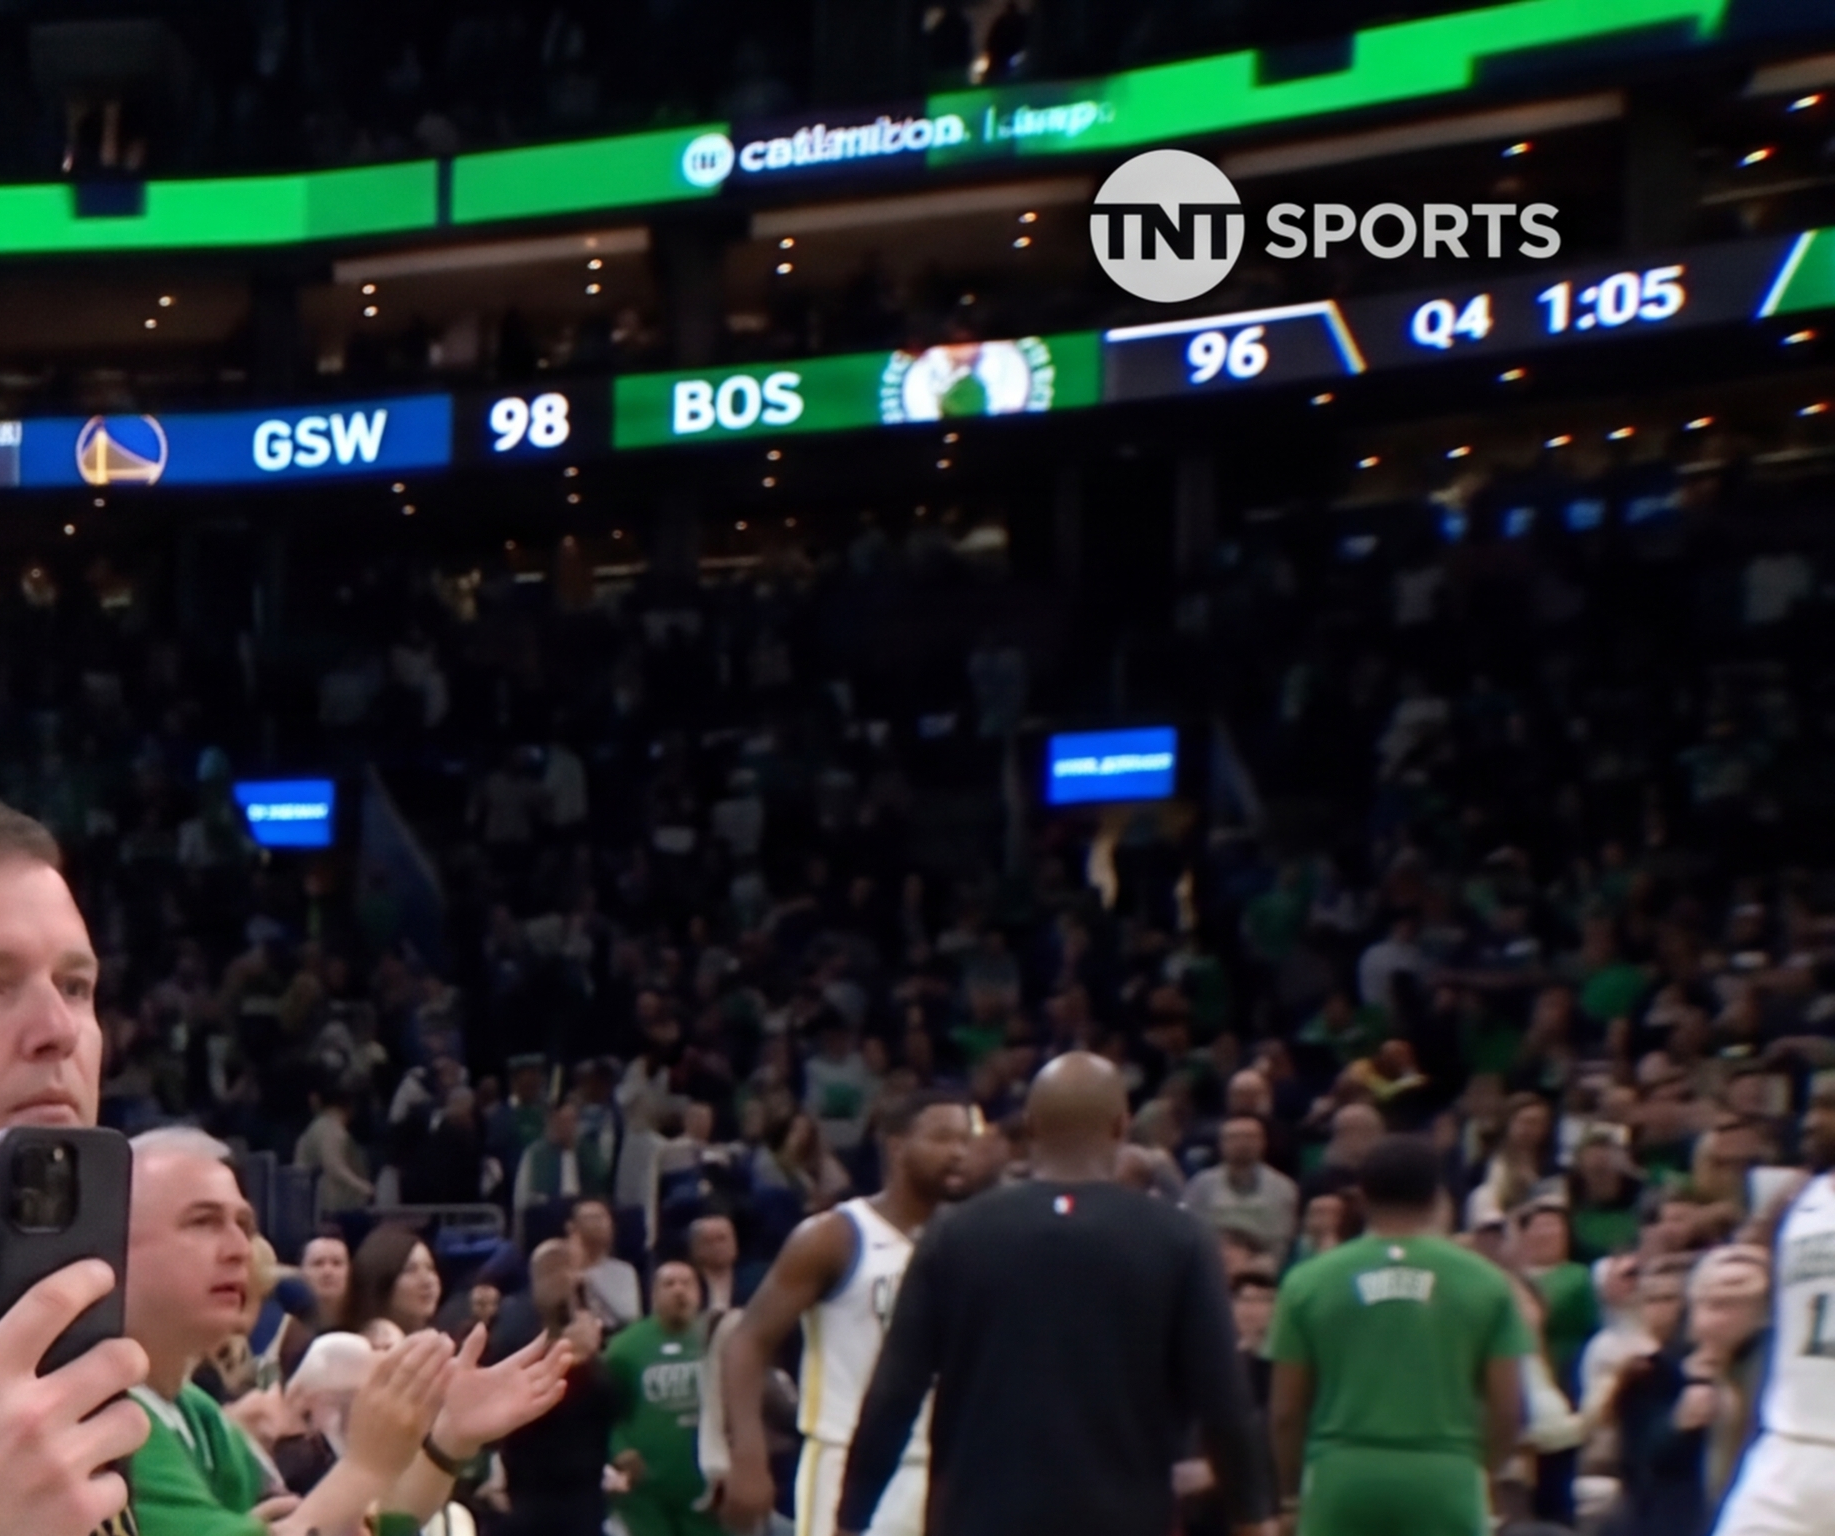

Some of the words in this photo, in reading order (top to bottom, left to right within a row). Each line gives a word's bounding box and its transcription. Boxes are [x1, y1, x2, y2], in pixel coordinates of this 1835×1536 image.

[253, 410, 387, 471] GSW
[489, 392, 571, 452] 98
[672, 371, 805, 434] BOS
[1186, 325, 1268, 385] 96
[1411, 293, 1493, 350] Q4
[1539, 265, 1686, 333] 1:05
